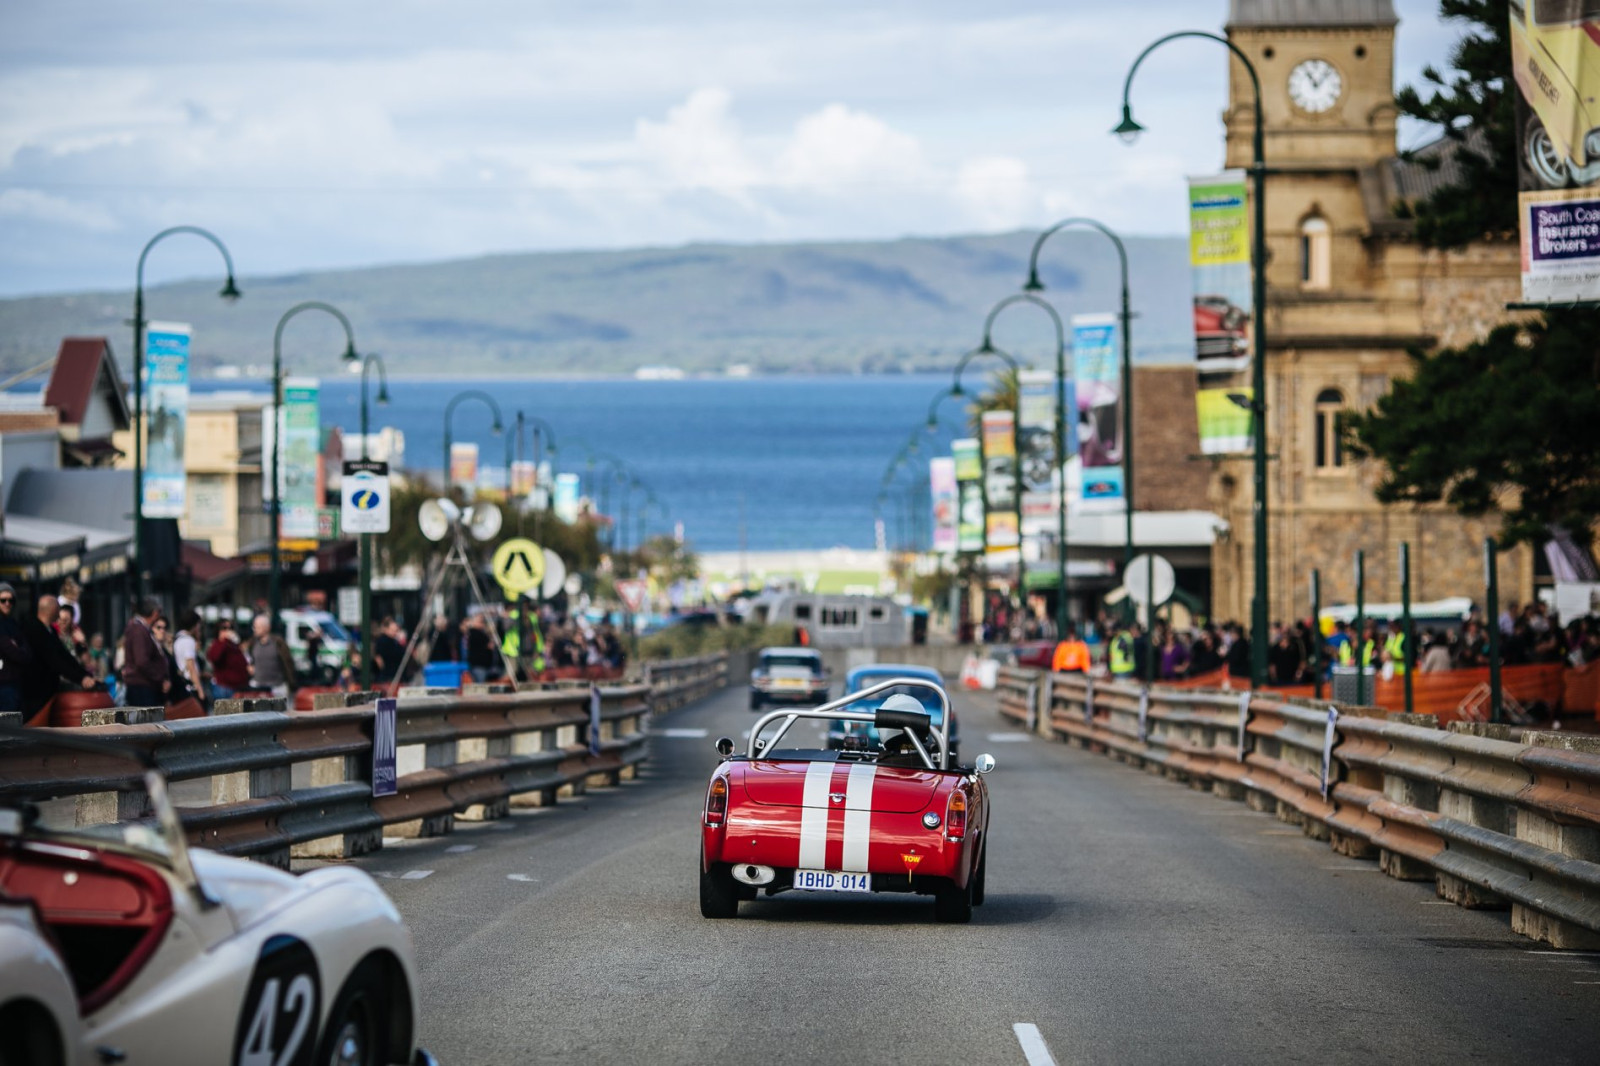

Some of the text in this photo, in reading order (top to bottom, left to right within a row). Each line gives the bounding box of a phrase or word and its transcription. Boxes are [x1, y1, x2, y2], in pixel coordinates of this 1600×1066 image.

[1538, 209, 1573, 226] South
[1538, 223, 1599, 240] Insurance
[1539, 238, 1588, 255] Brokers
[903, 855, 921, 863] TOW
[241, 975, 315, 1066] 42
